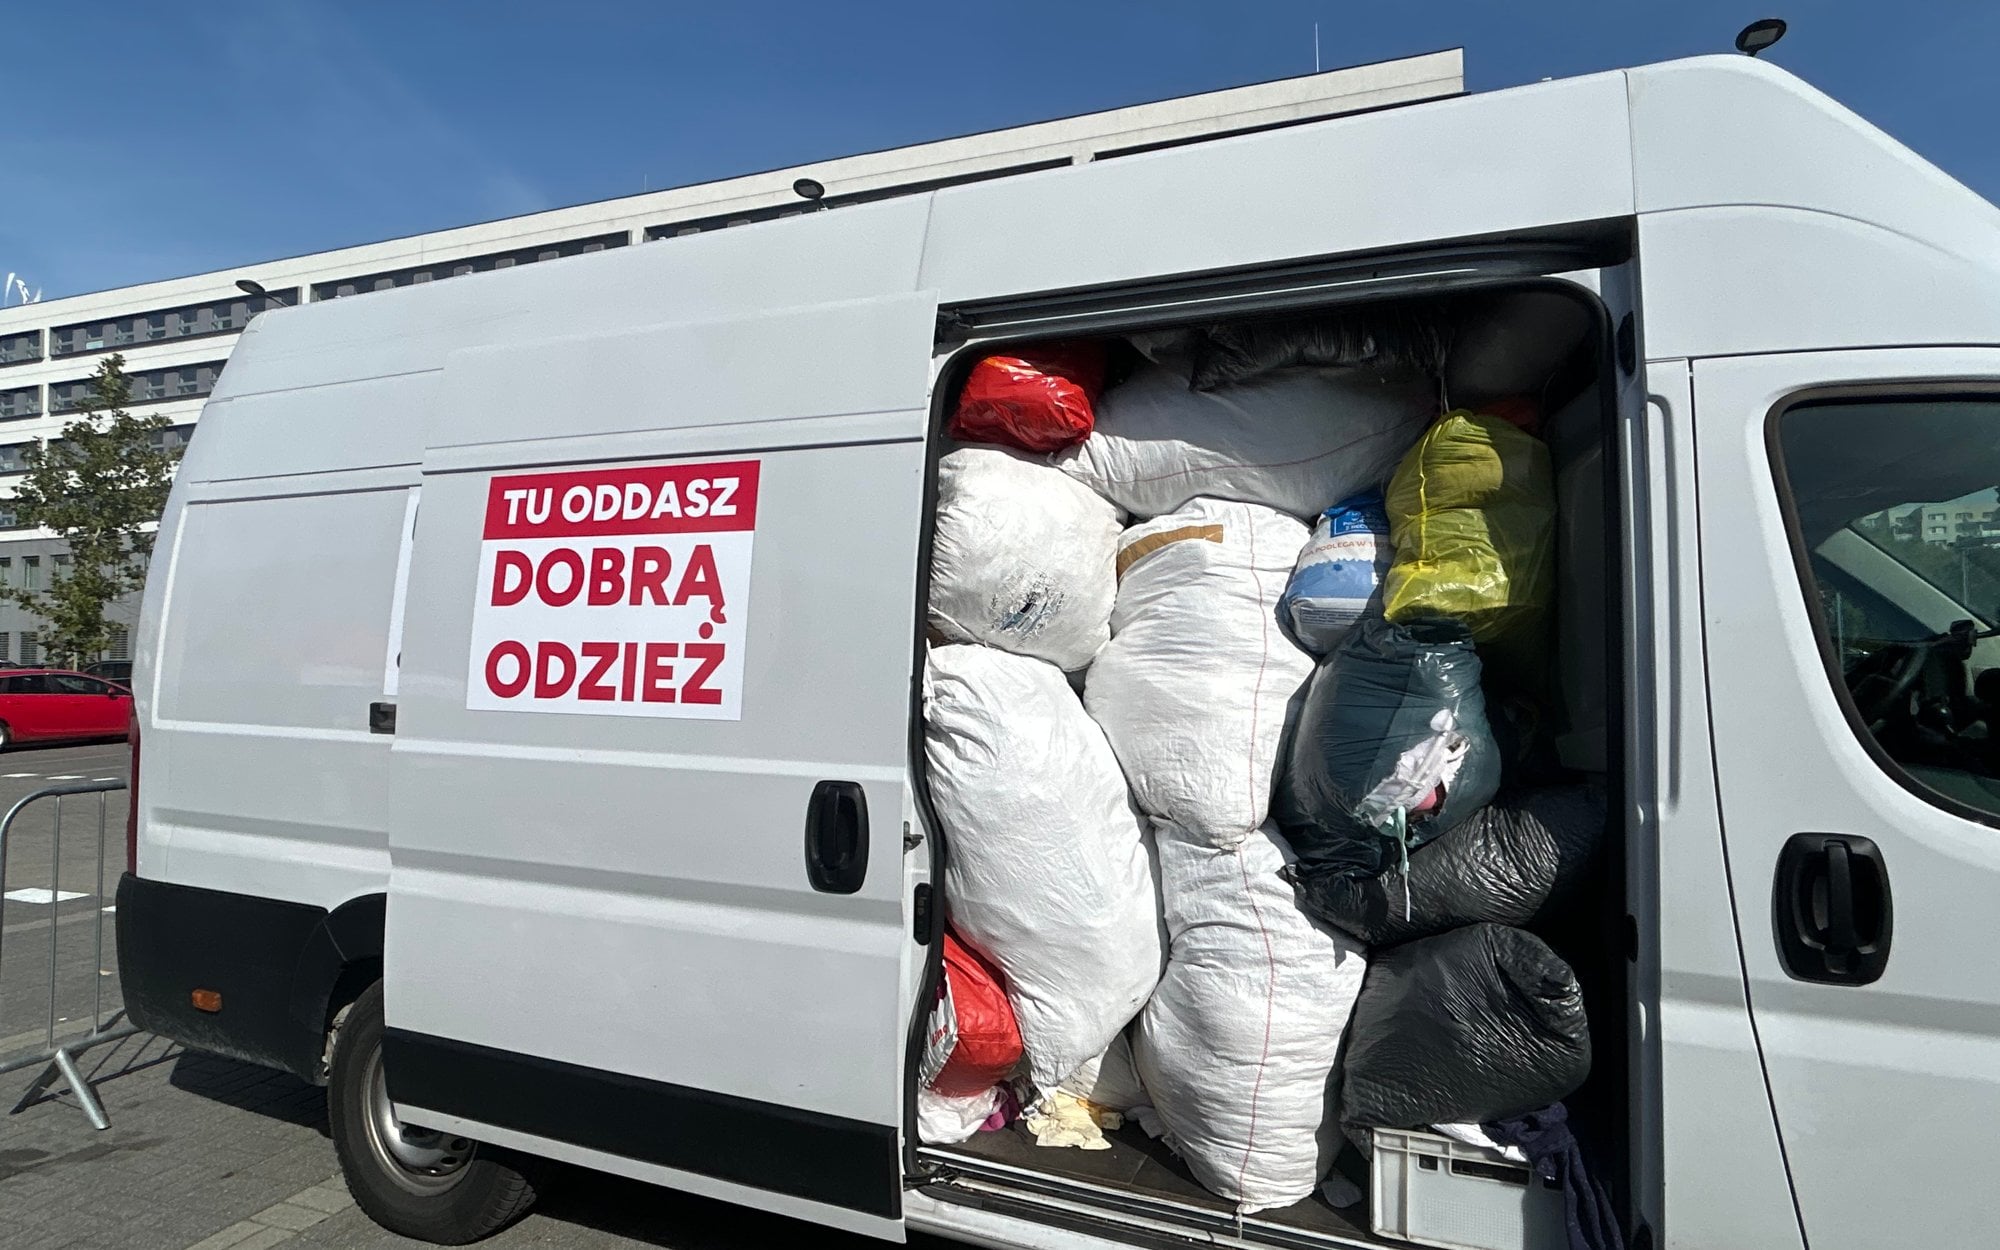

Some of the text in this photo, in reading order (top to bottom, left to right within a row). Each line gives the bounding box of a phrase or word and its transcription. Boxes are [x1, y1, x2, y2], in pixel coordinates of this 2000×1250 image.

[503, 477, 740, 525] TU ODDASZ
[490, 544, 727, 624] DOBRĄ
[485, 622, 726, 705] ODZIEŻ
